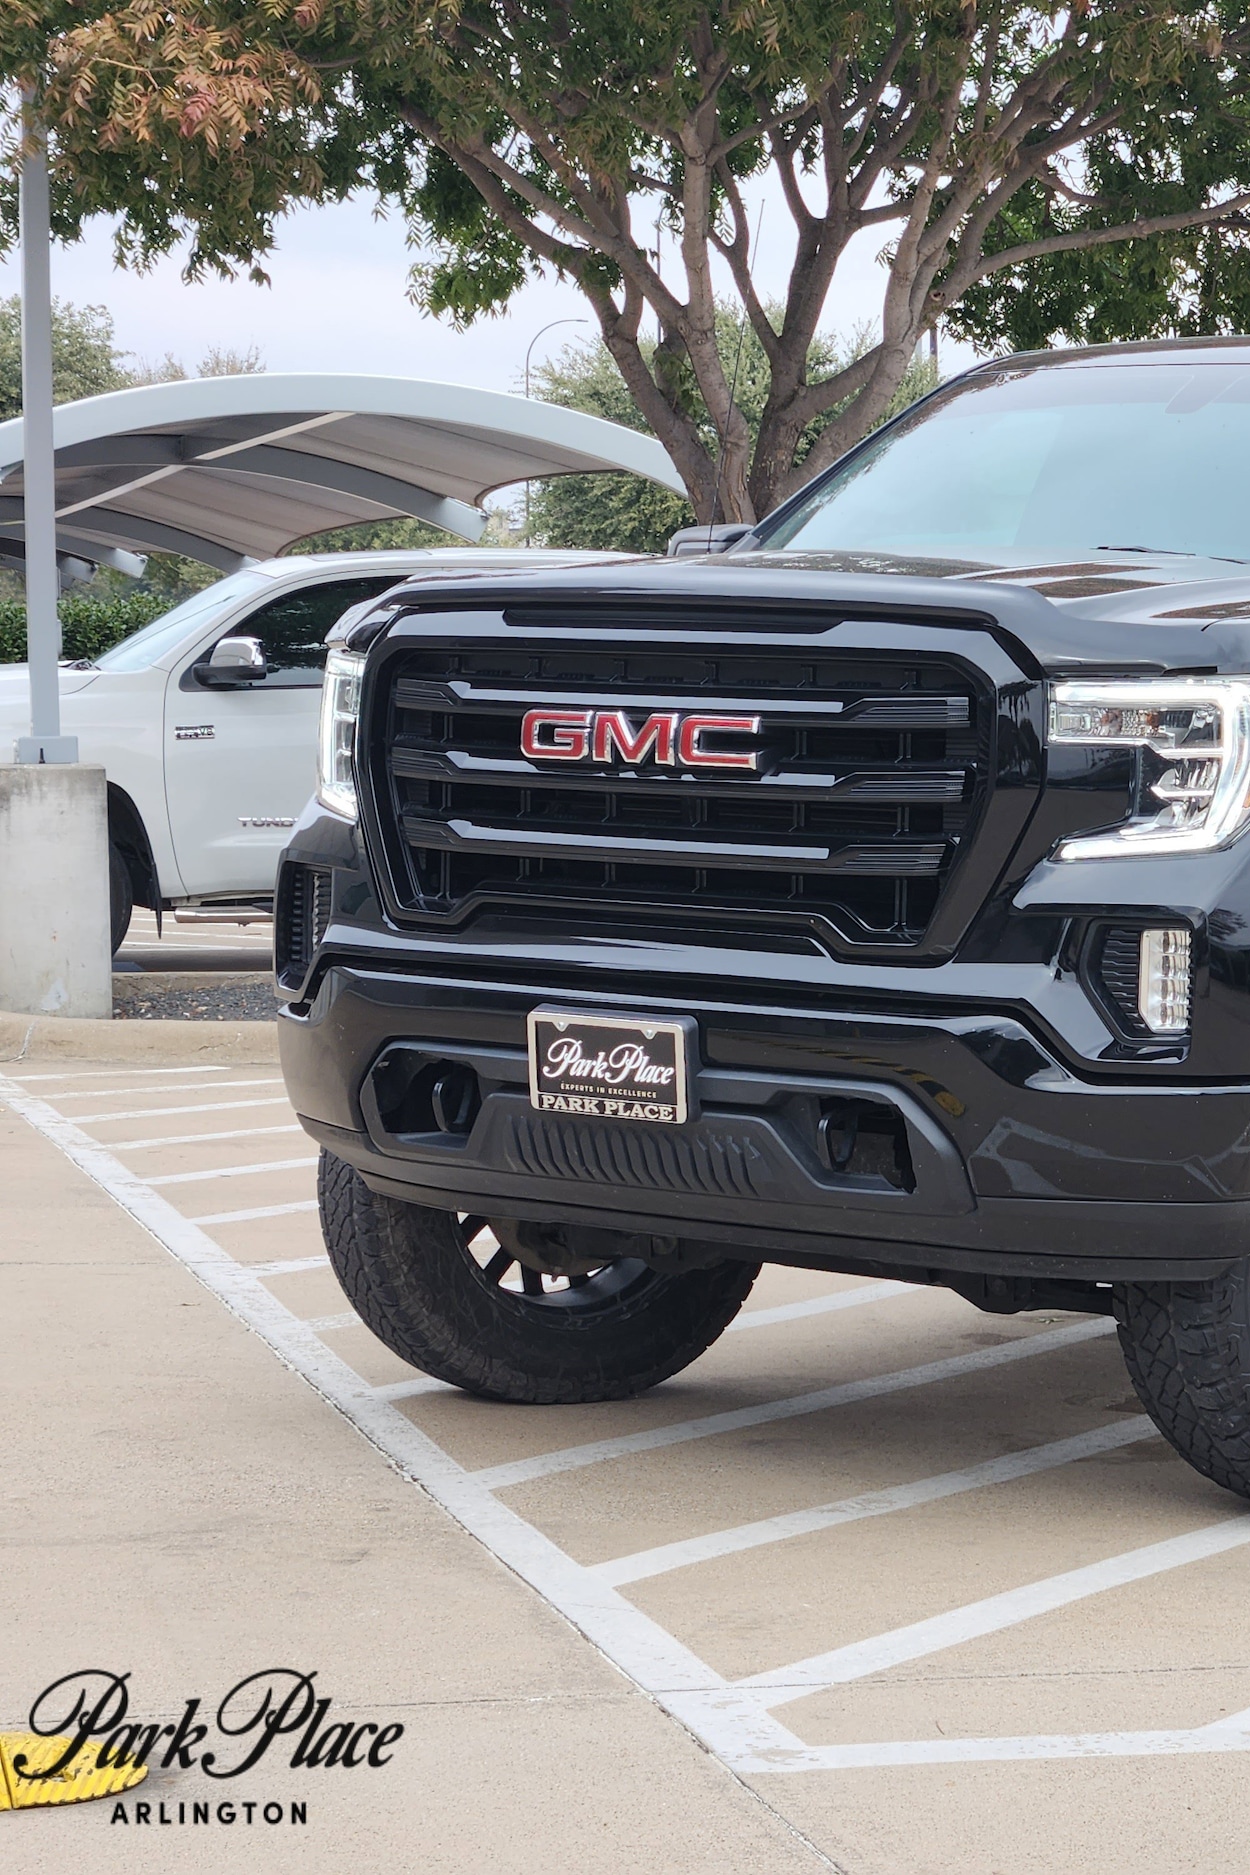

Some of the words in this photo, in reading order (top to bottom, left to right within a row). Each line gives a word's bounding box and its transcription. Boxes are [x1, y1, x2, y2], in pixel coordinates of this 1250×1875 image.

[520, 709, 761, 770] GMC
[237, 817, 299, 827] TUND
[542, 1037, 607, 1078] Park
[604, 1043, 675, 1085] Place
[560, 1082, 594, 1093] EXPERTS
[596, 1086, 605, 1094] IN
[607, 1087, 657, 1099] EXCELLENCE
[541, 1094, 600, 1114] PARK
[603, 1101, 674, 1121] PLACE
